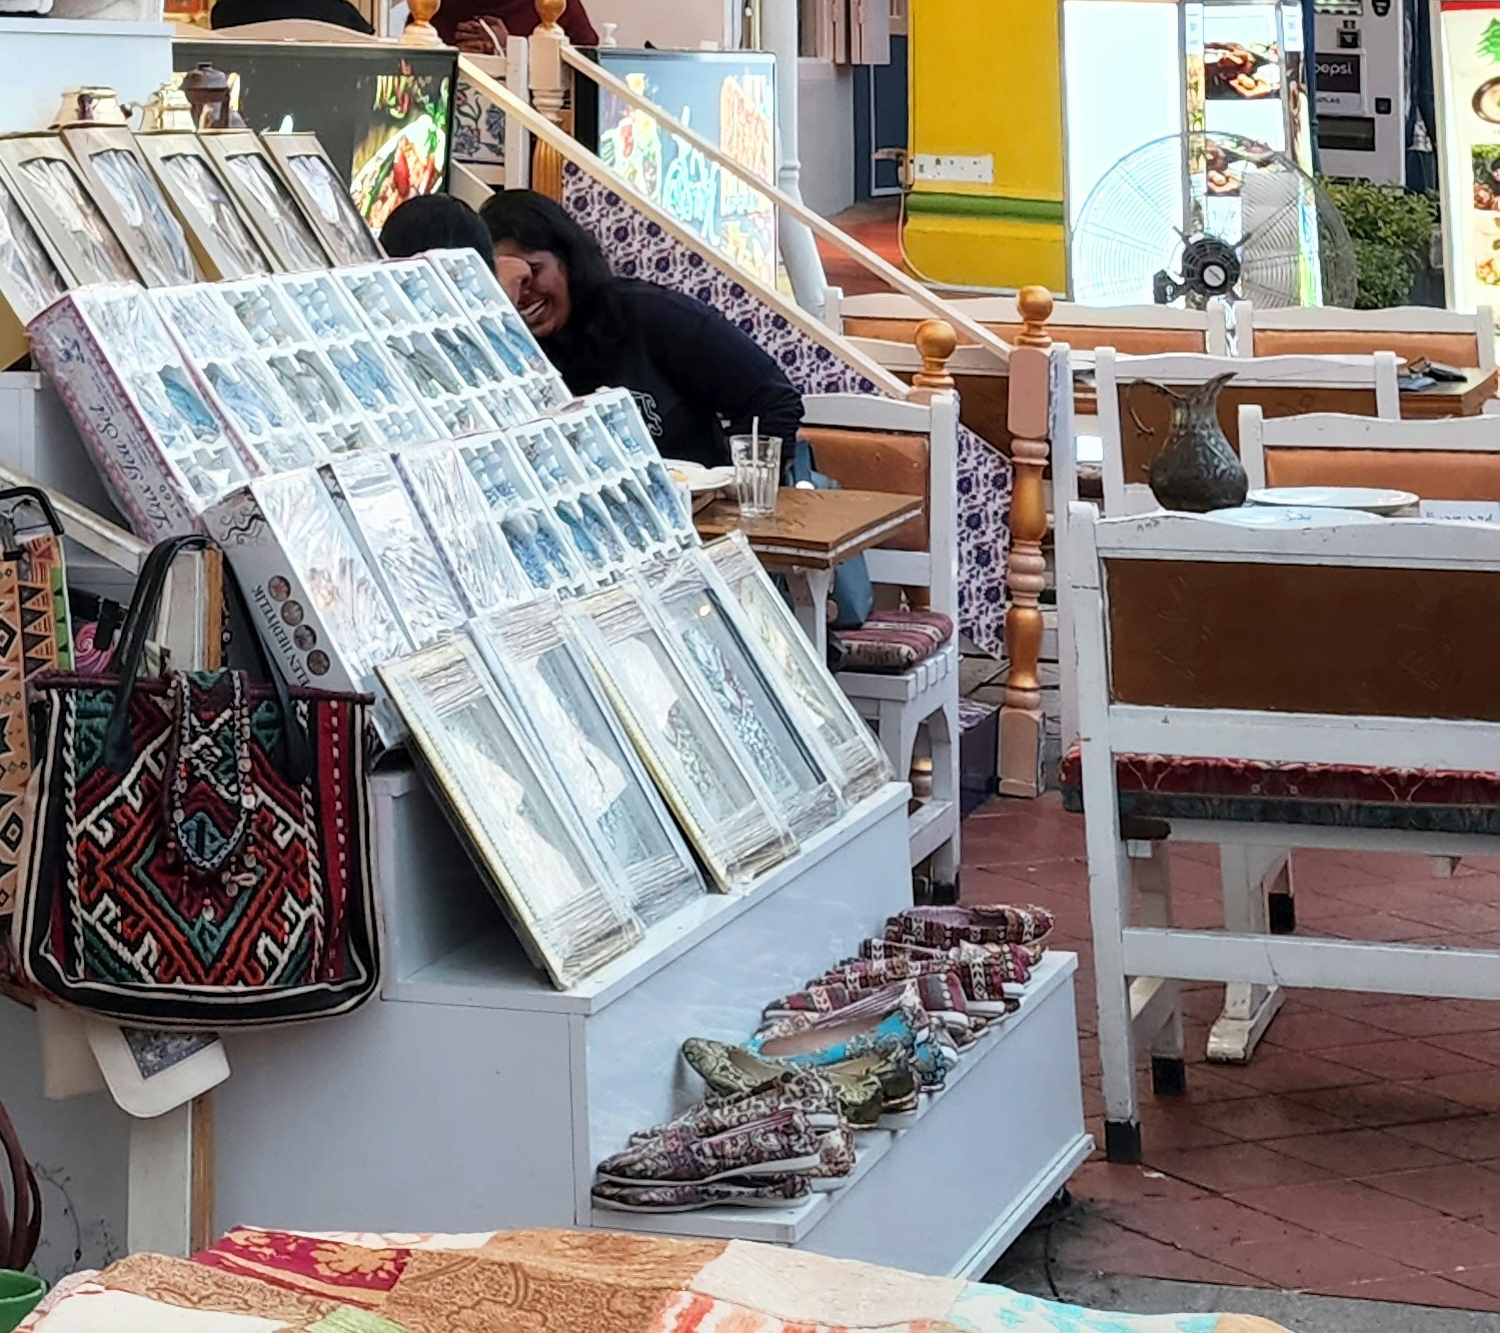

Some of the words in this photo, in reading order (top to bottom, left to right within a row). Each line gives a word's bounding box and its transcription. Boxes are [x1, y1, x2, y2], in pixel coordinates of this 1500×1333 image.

[89, 404, 119, 440] Set
[115, 442, 144, 481] Tea
[139, 481, 173, 531] Lux
